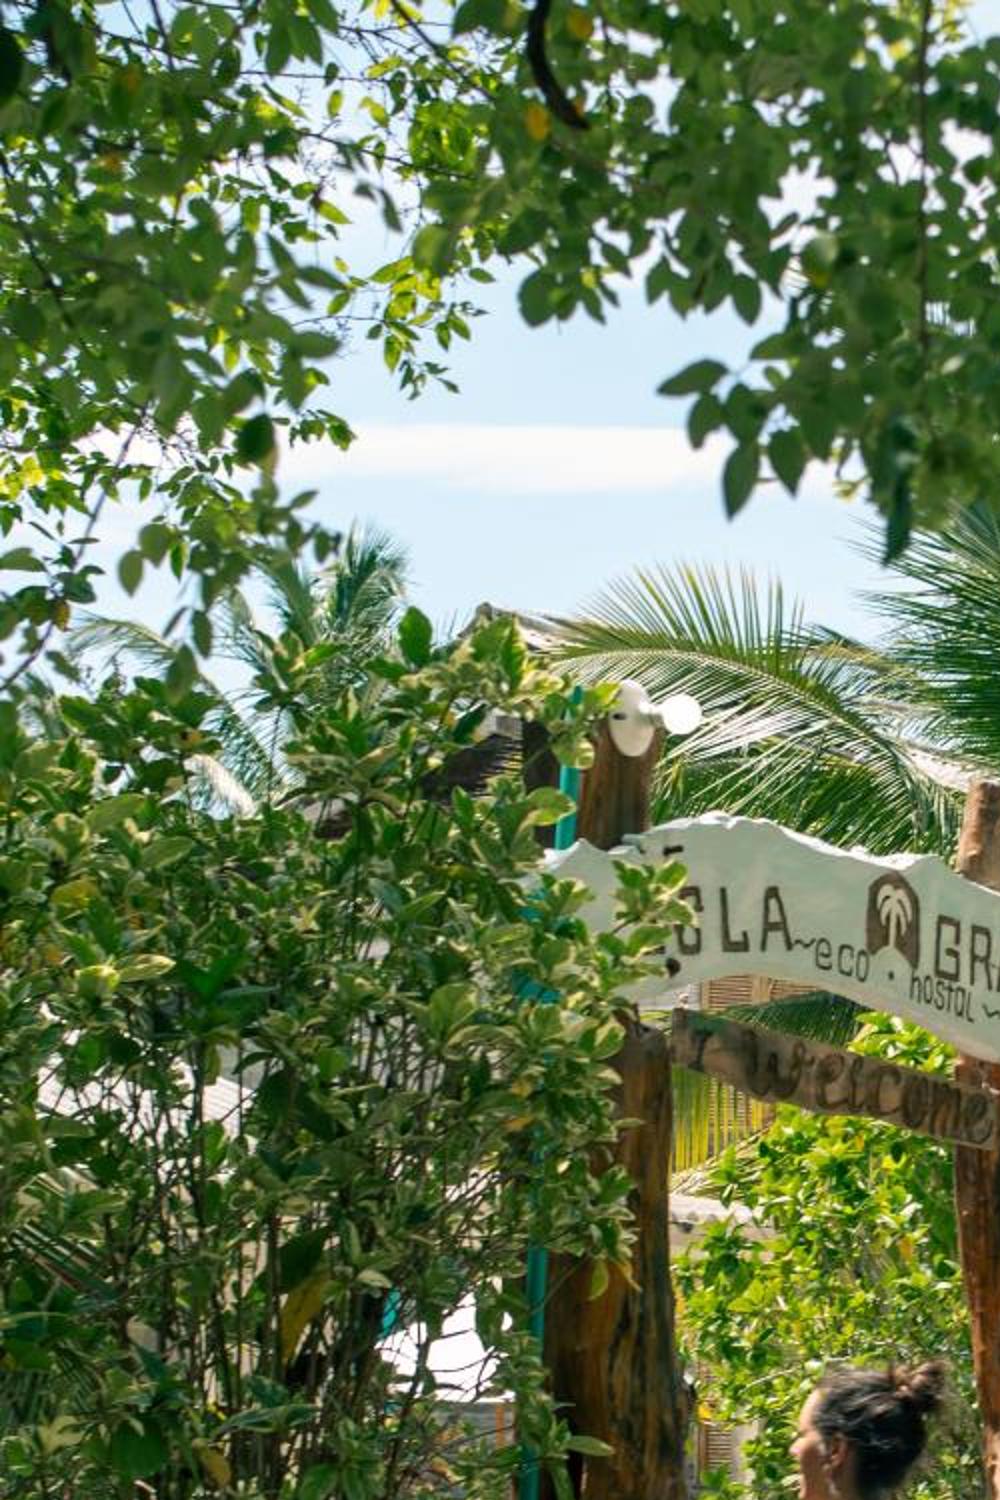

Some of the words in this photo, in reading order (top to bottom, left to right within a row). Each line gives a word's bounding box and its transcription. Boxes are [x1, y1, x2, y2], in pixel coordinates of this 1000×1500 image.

[641, 886, 795, 955] SLA
[814, 937, 870, 983] eco
[909, 967, 975, 1024] hostal
